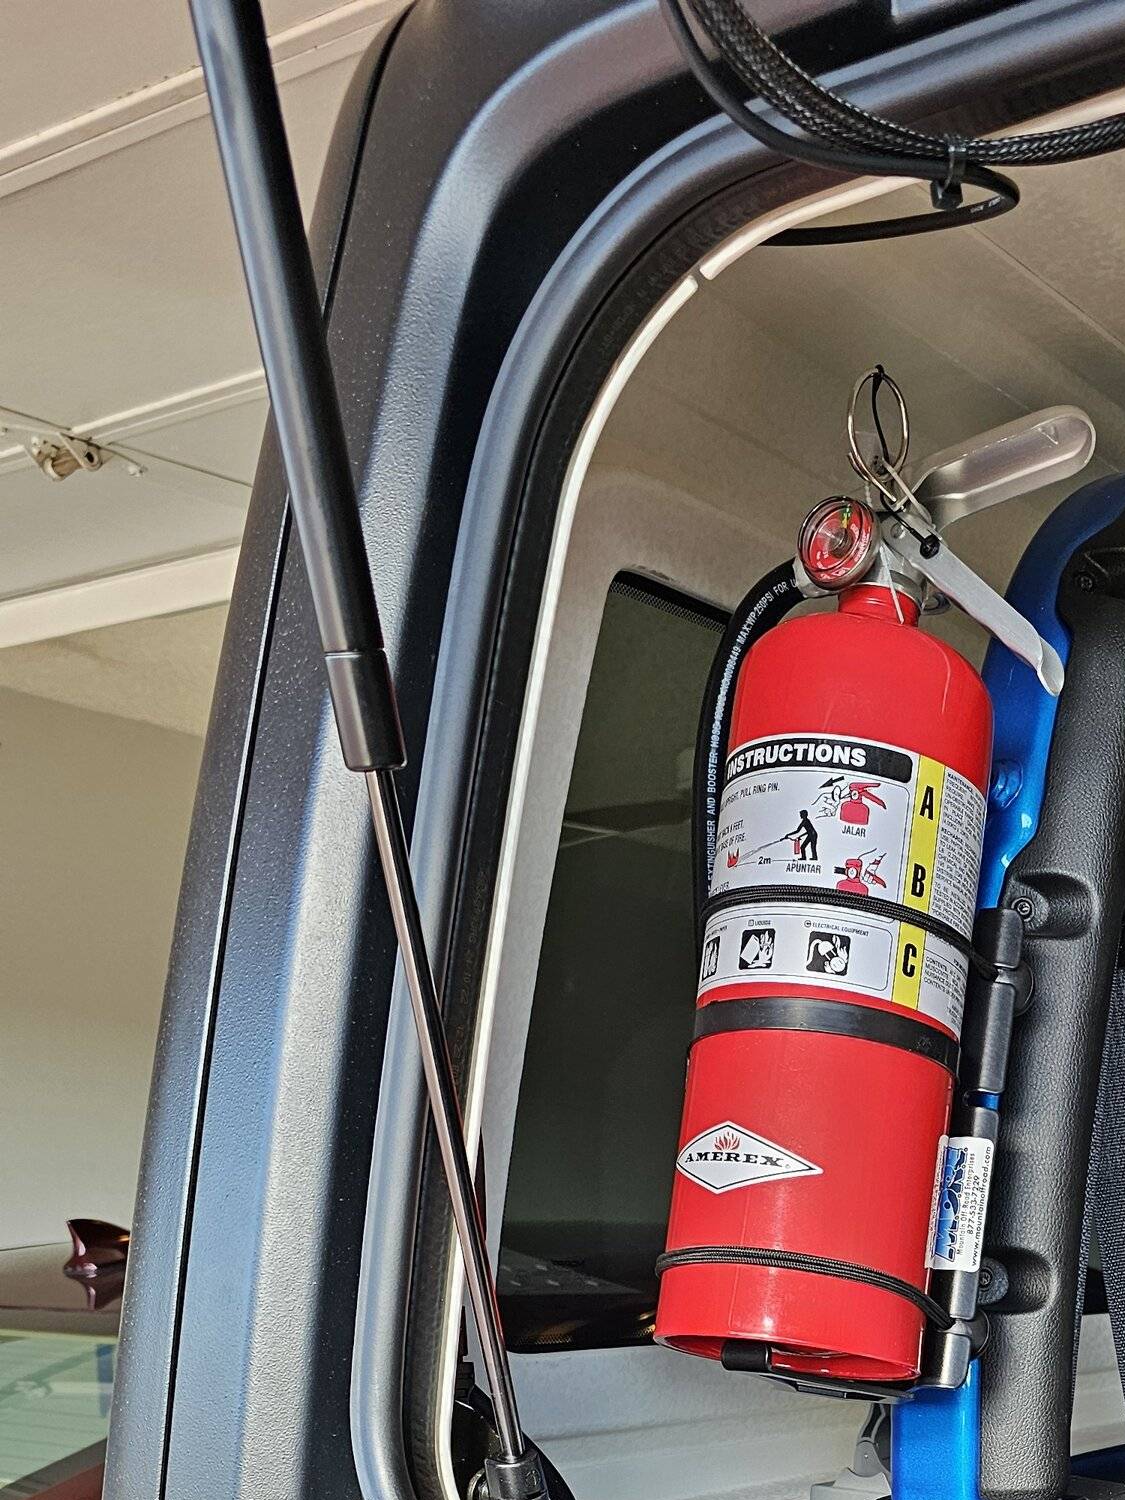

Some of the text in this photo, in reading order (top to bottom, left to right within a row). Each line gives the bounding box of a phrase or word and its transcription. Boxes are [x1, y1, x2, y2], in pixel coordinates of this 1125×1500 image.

[706, 797, 716, 815] AND
[772, 581, 789, 597] FOR
[727, 743, 867, 780] INSTRUCTIONS
[919, 785, 934, 821] A
[841, 825, 867, 838] JALAR
[758, 856, 771, 864] 2m
[785, 863, 822, 874] APUNTAR
[911, 863, 927, 898] B
[902, 943, 917, 978] C
[685, 1151, 784, 1168] AMEREX
[964, 1153, 976, 1190] Enterprises
[967, 1175, 980, 1235] 877-533-7229
[972, 1146, 992, 1267] www.mountainoffroad.com
